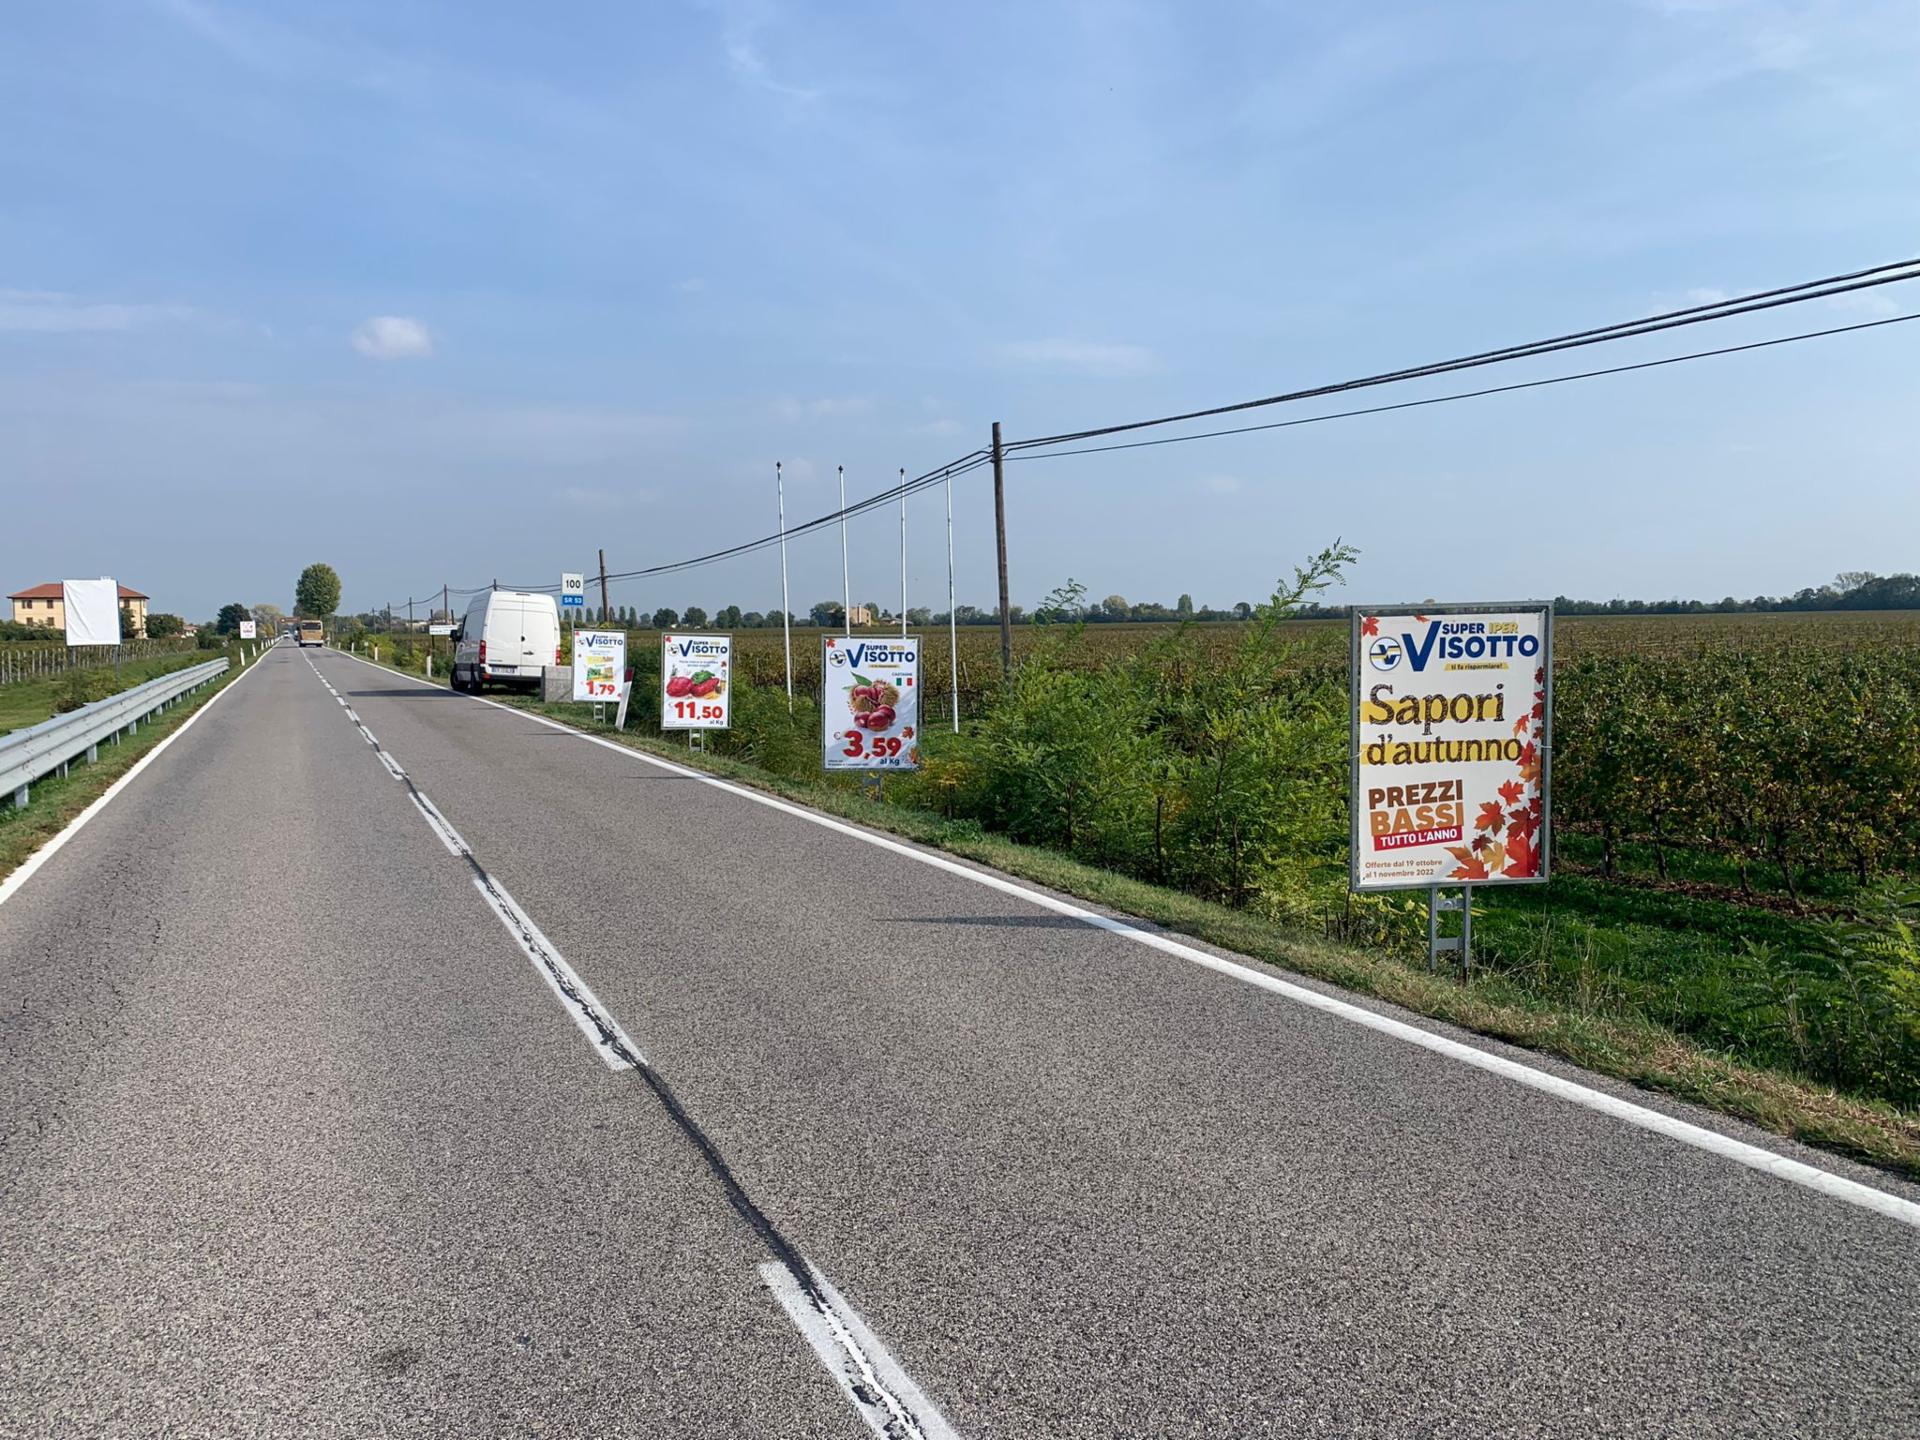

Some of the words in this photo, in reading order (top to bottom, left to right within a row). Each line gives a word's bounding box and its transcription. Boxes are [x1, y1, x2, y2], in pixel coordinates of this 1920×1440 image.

[566, 580, 581, 588] 100
[1442, 623, 1485, 635] SUPER
[1488, 622, 1518, 634] IPER
[586, 634, 624, 647] VISOTTO
[679, 640, 728, 657] VISOTTO
[1401, 620, 1539, 672] VISOTTO
[846, 643, 916, 668] VISOTTO
[586, 680, 615, 696] 1,79
[674, 701, 723, 720] 11,50
[1368, 683, 1505, 736] Sapori
[842, 730, 902, 760] 3,59
[1366, 734, 1523, 766] d'autunno
[889, 758, 900, 766] Kg
[1368, 779, 1463, 810] PREZZI
[1370, 802, 1464, 836] BASSI
[1380, 834, 1417, 847] TUTTO
[1418, 828, 1458, 842] L'ANNO
[1365, 861, 1392, 869] Offerte
[1393, 860, 1404, 868] dal
[1416, 859, 1442, 867] ottobre
[1379, 870, 1415, 878] novembre
